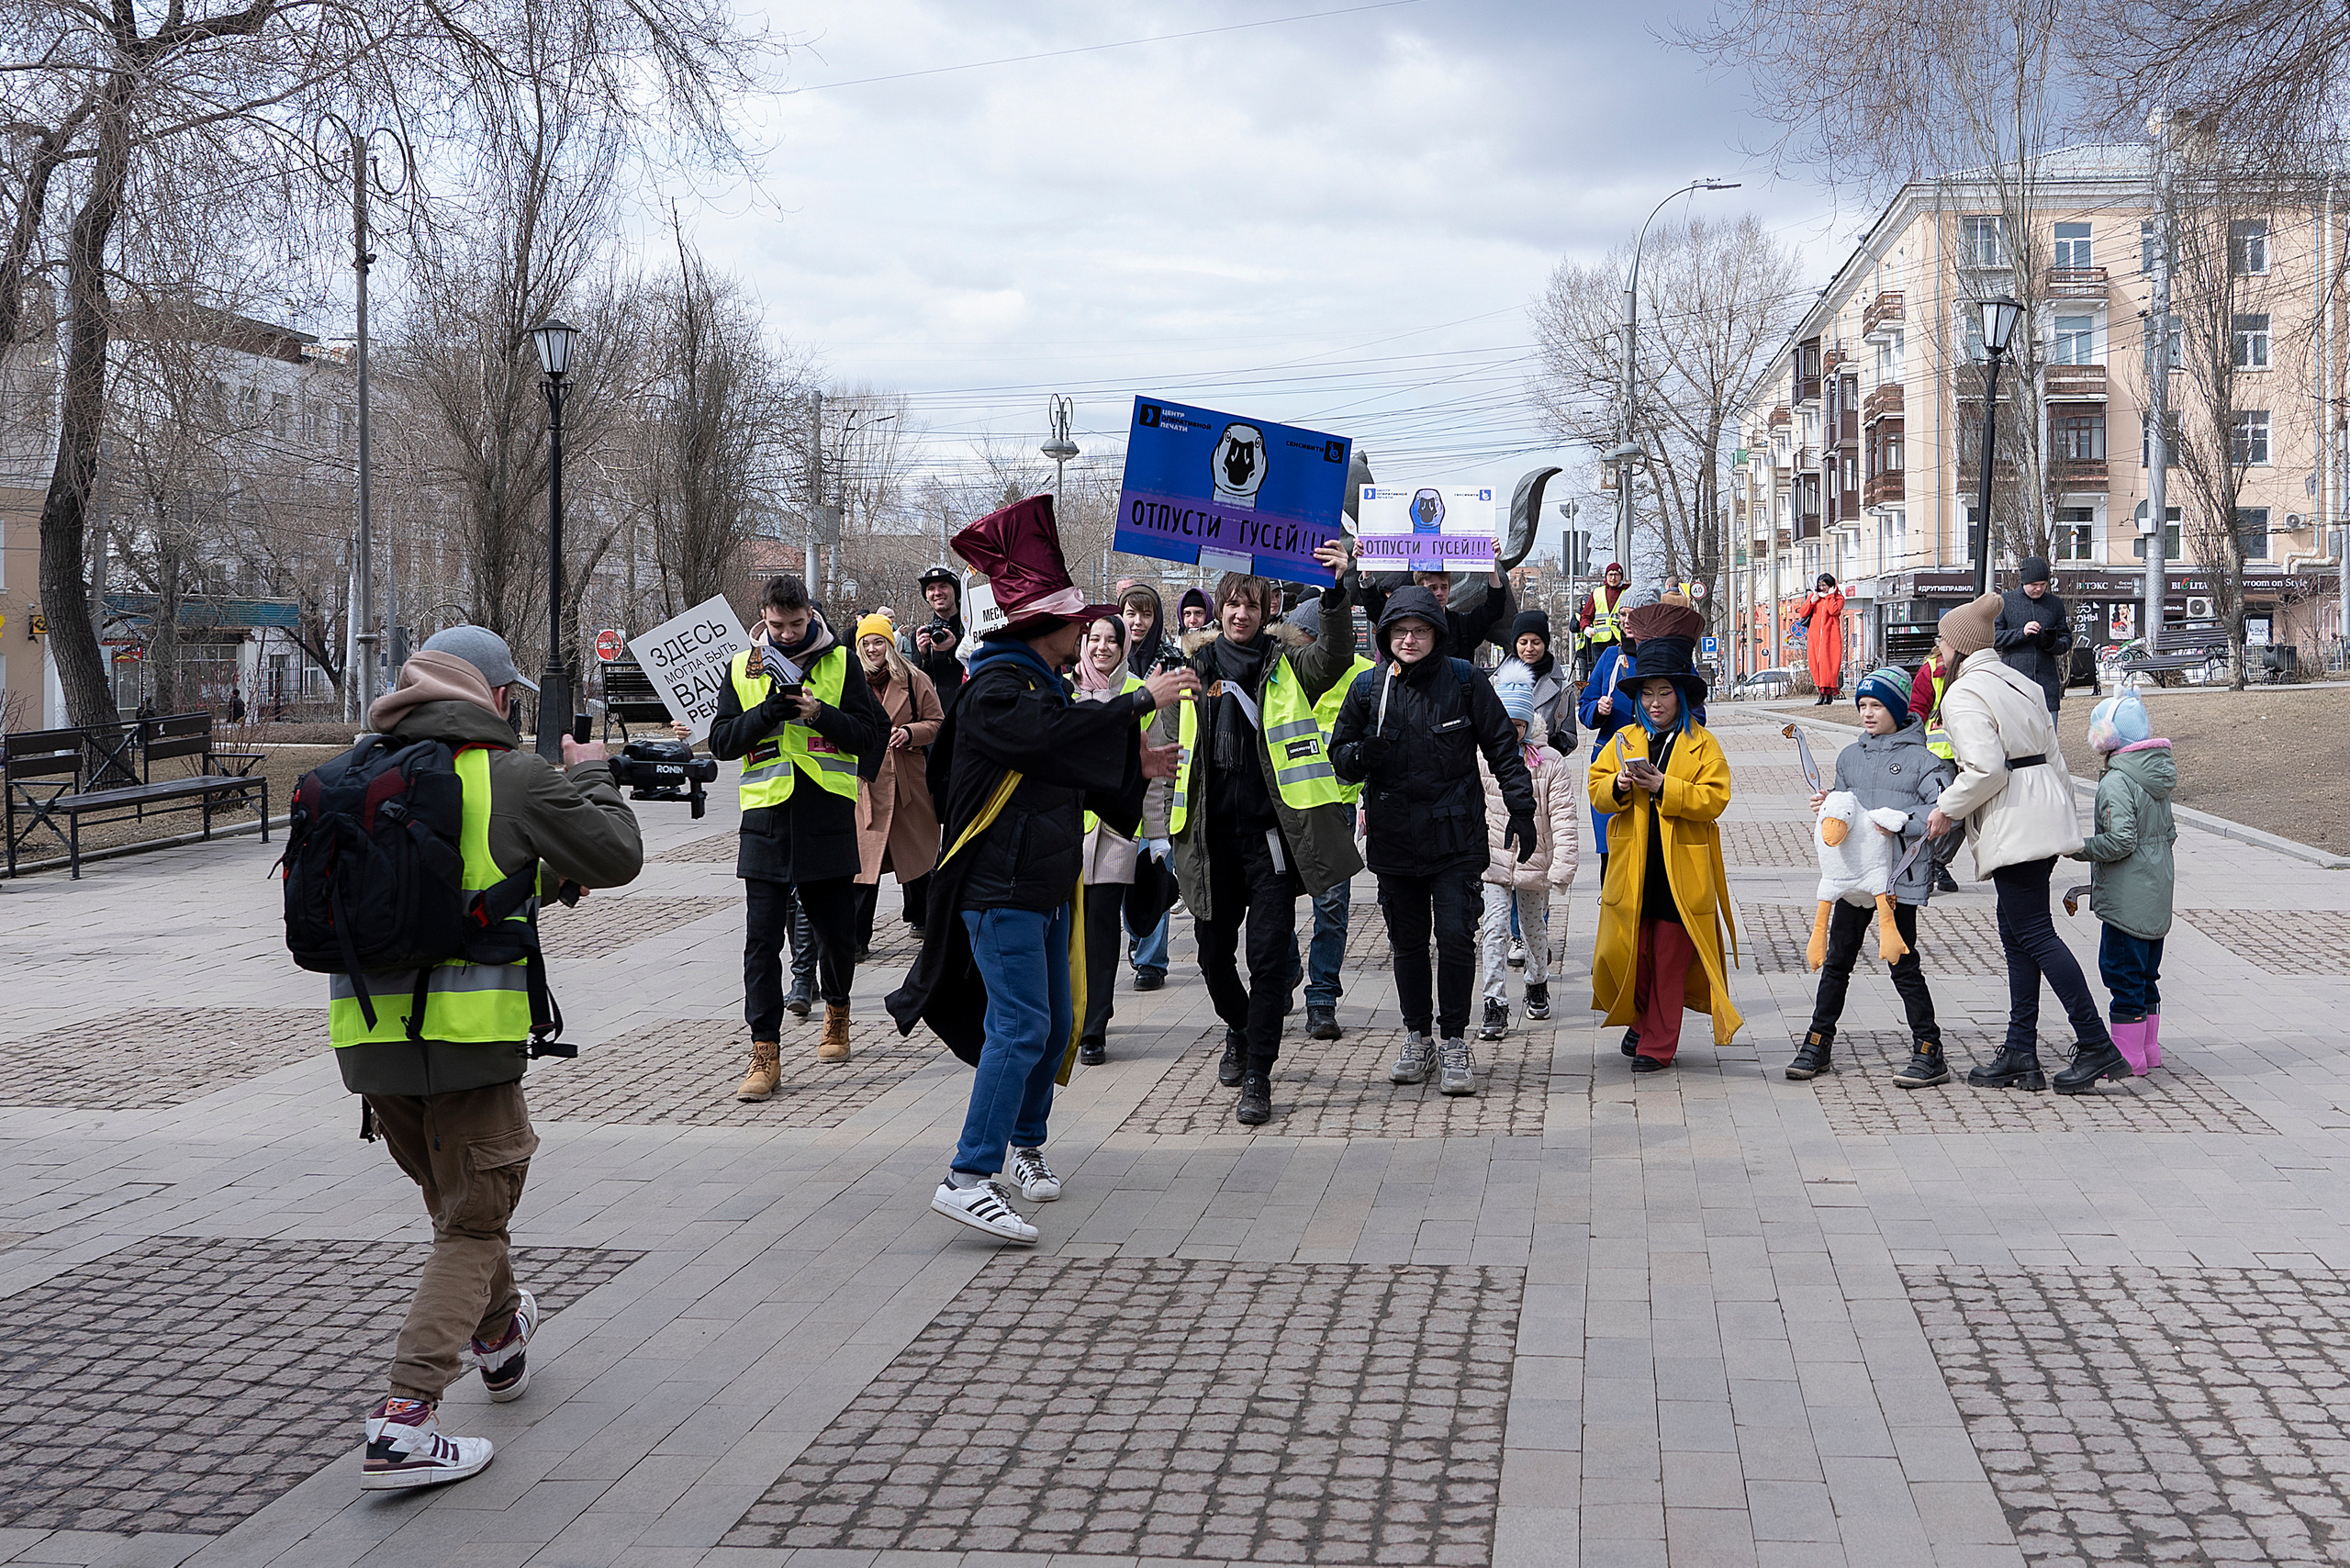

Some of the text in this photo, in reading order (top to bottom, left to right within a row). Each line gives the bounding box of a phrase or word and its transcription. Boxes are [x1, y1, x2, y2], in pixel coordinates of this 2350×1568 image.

[1162, 409, 1185, 418] ЦЕНТР
[1160, 421, 1188, 432] ПЕЧАТИ
[1161, 416, 1212, 430] ОПЕРАТИВНОЙ
[1131, 499, 1222, 539] ОТПУСТИ
[1366, 539, 1486, 555] ОТПУСТИ ГУСЕЙ!!!
[982, 606, 1005, 623] МЕСТ
[650, 620, 727, 667] ЗДЕСЬ
[664, 642, 738, 685] МОГЛА БЫТЬ
[671, 661, 727, 709] ВАШ
[687, 698, 719, 724] РЕК
[656, 765, 684, 774] RONIN
